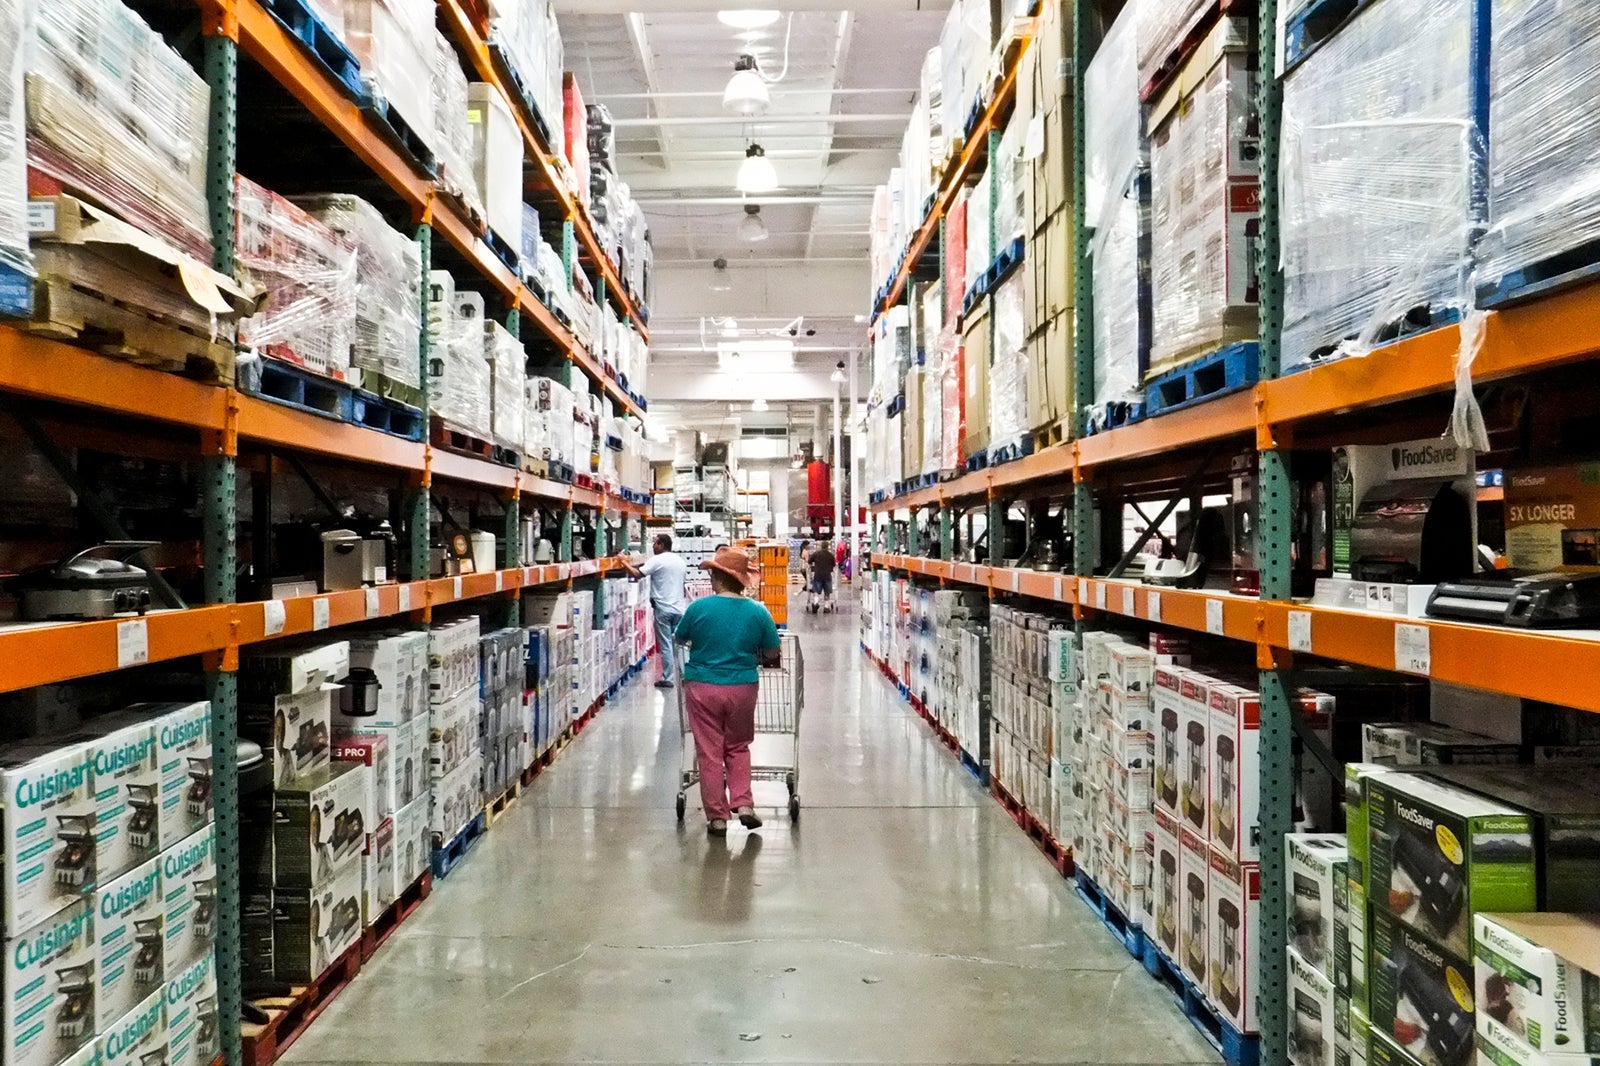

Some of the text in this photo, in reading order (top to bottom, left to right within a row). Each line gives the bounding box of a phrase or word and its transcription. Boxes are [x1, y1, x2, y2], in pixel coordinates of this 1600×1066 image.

[1402, 446, 1457, 466] FoodSaver
[1527, 504, 1575, 520] LONGER
[1059, 637, 1068, 680] Cuisinart
[161, 715, 210, 750] Cuisinart
[95, 736, 156, 776] Cuisinart
[345, 748, 366, 757] PRO
[16, 757, 95, 809] Cuisinart
[1397, 801, 1434, 831] FoodSaver
[1483, 820, 1529, 830] FoodSaver
[164, 832, 215, 880] Cuisinart
[1294, 846, 1328, 878] FoodSaver
[101, 863, 162, 920] Cuisinart
[15, 906, 96, 970] Cuisinart
[1405, 931, 1444, 968] FoodSaver
[1489, 930, 1525, 959] FoodSaver
[168, 950, 215, 1005] Cuisinart
[1295, 960, 1329, 1000] FoodSaver
[1555, 962, 1567, 1032] FoodSaver
[106, 993, 168, 1060] Cuisinart
[1493, 1025, 1531, 1061] FoodSaver
